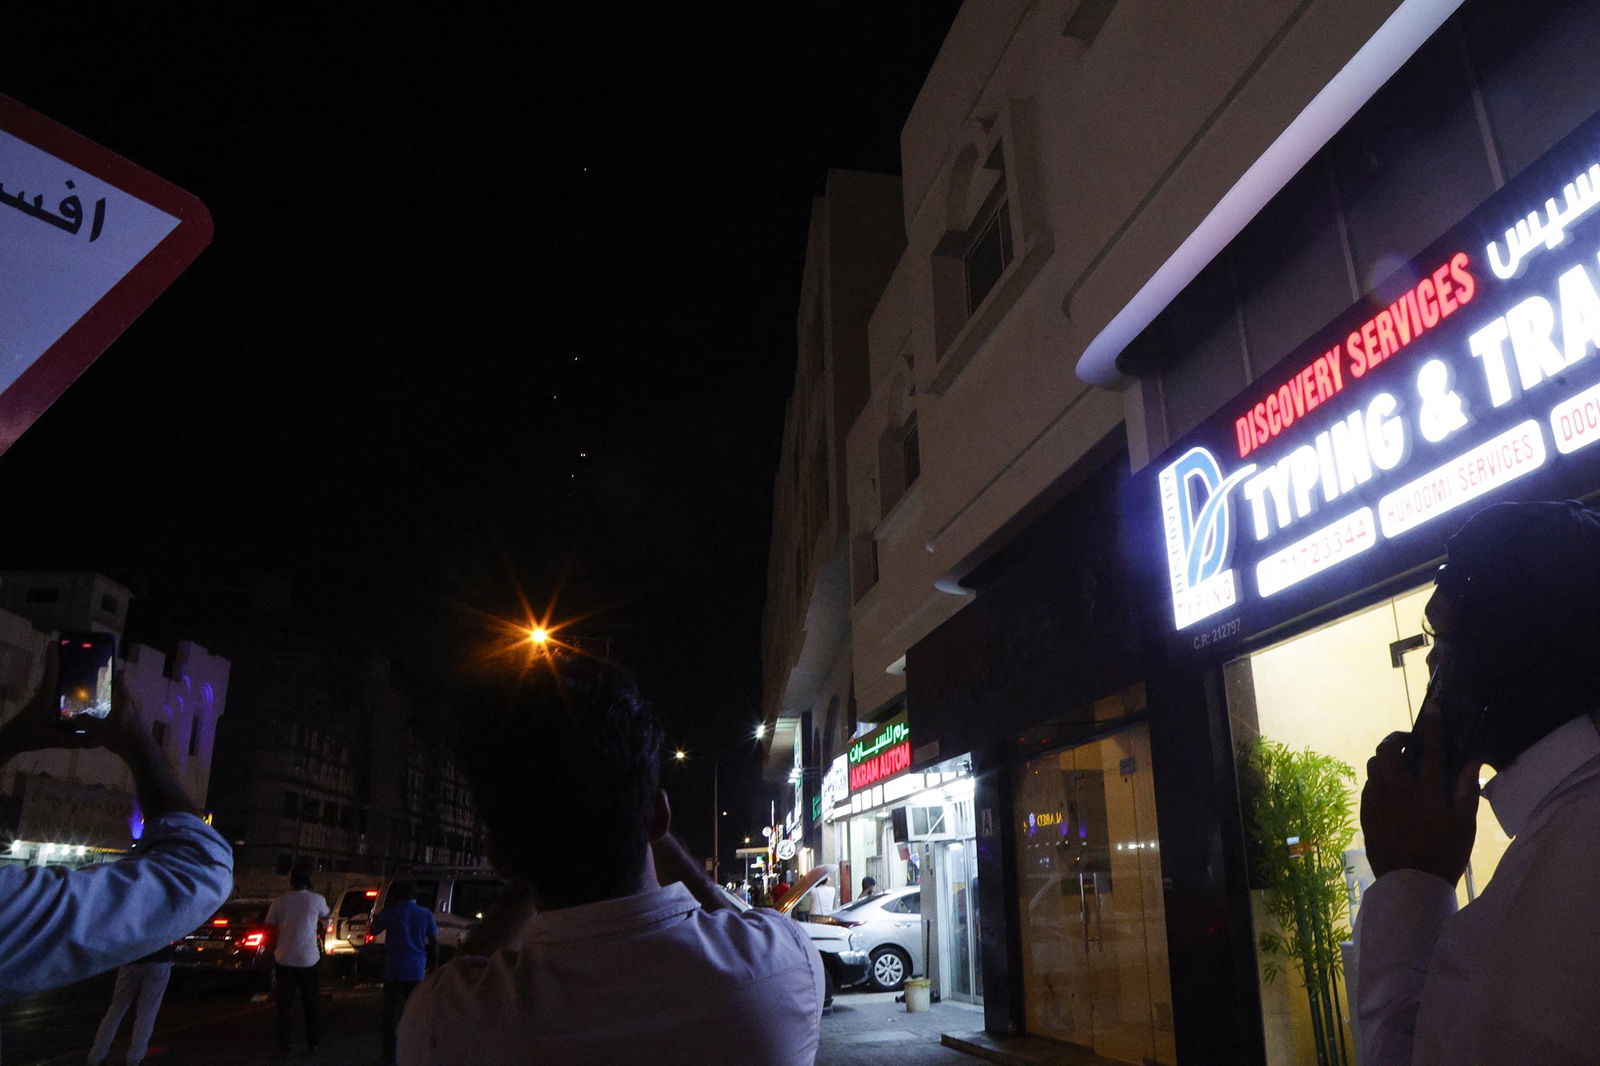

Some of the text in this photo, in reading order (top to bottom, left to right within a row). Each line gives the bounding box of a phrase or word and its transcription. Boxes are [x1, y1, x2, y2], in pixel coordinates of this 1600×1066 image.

[0, 180, 106, 243] افس
[1235, 251, 1476, 458] DISCOVERY SERVICES
[1245, 251, 1600, 541] TYPING & TRA
[1385, 433, 1535, 529] HUKOOMI SERVICES
[1211, 617, 1241, 642] 212797
[850, 754, 879, 791] AKRAM
